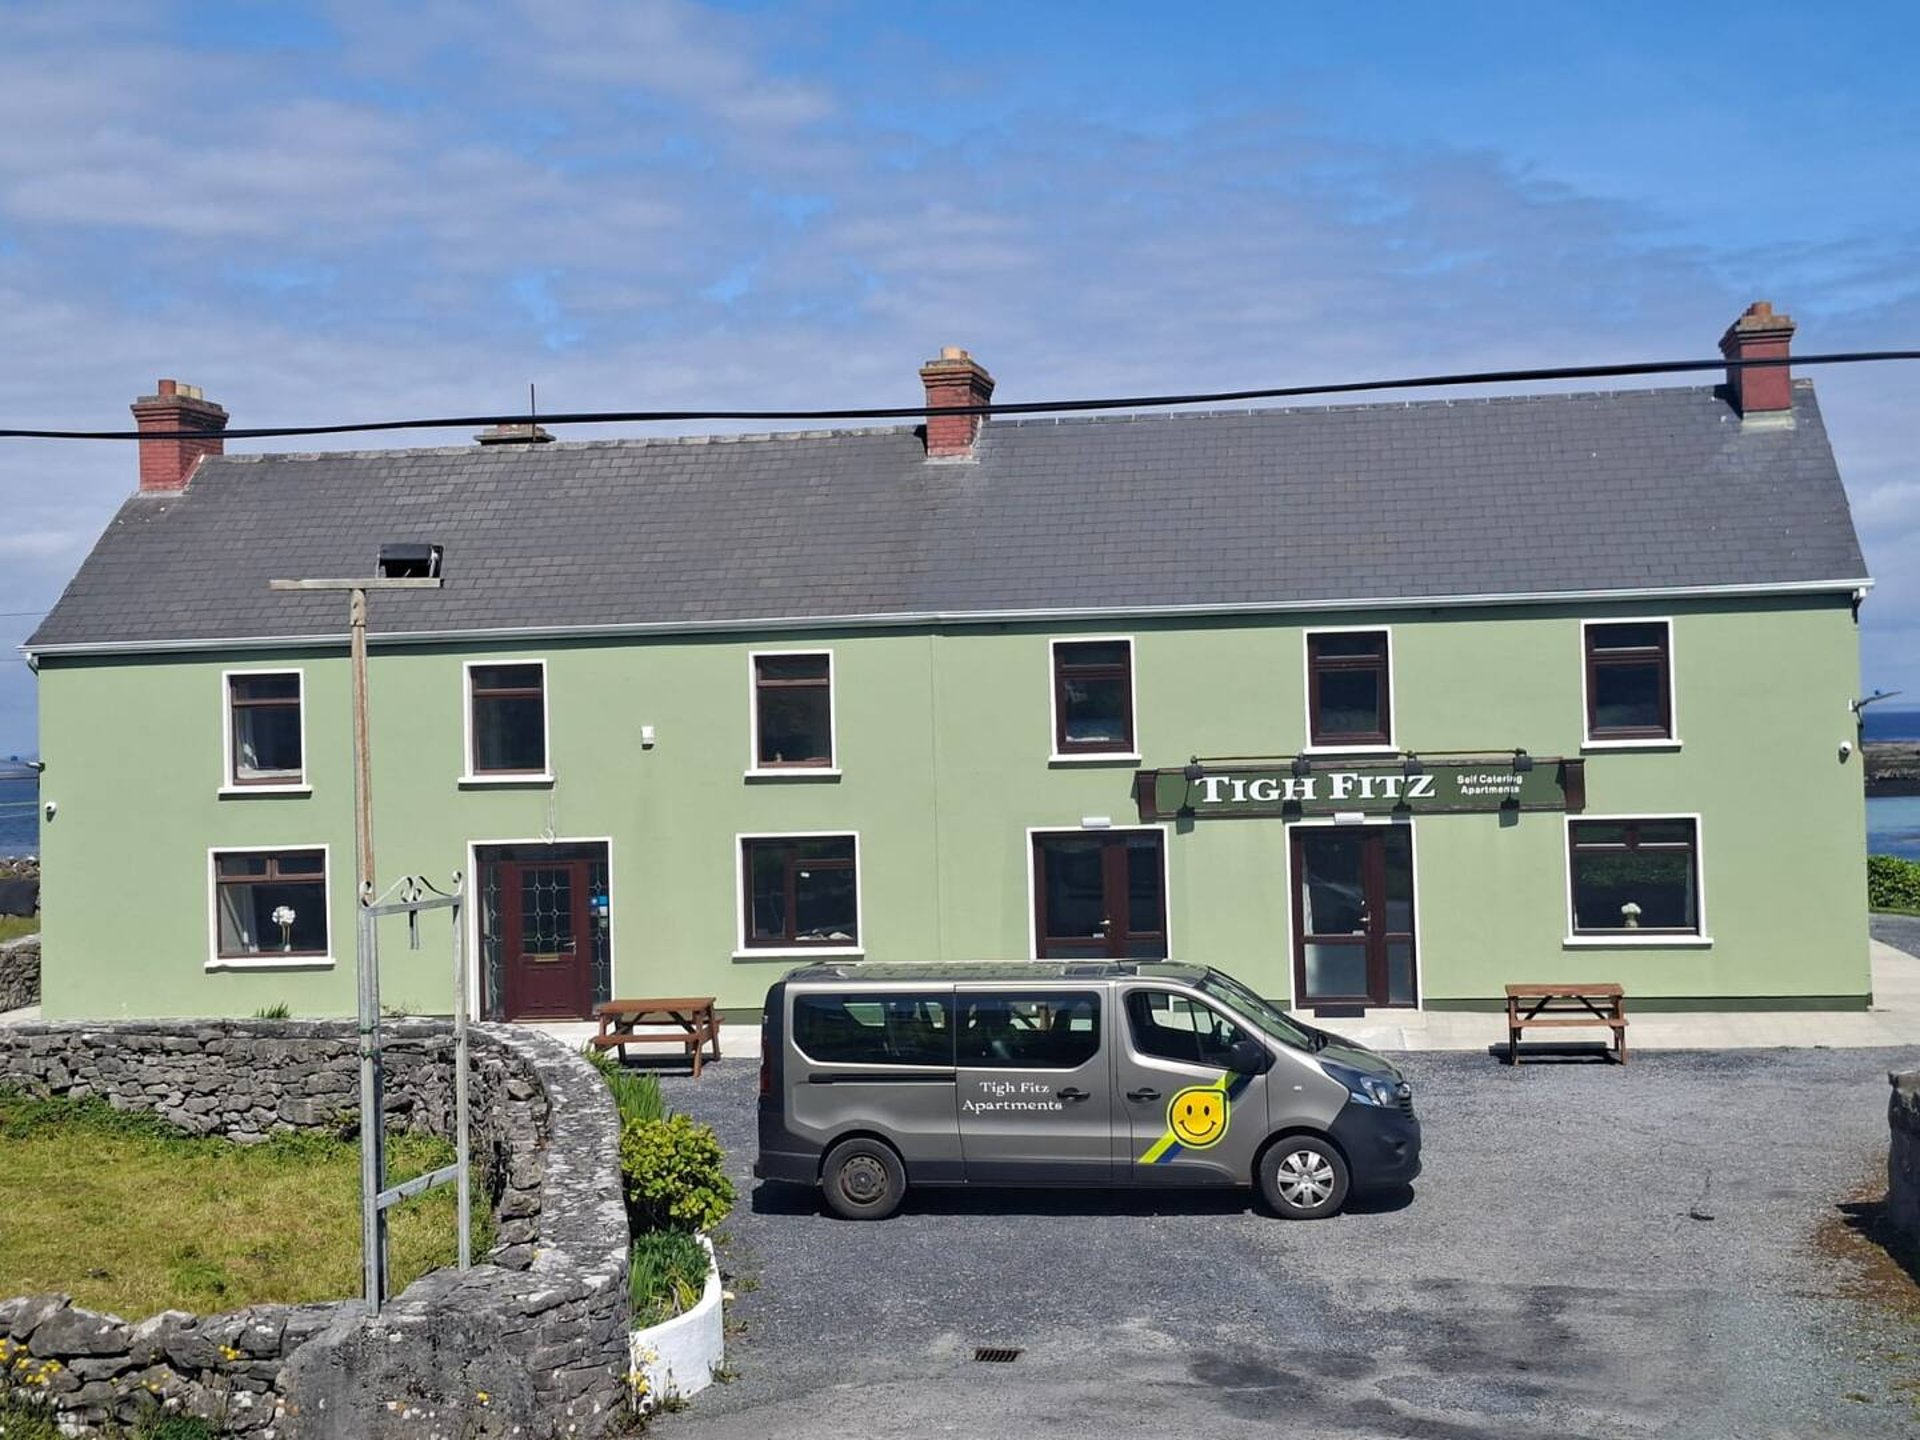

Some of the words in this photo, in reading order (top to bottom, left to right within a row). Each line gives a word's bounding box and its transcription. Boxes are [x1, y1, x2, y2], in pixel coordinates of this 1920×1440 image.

[1456, 774, 1477, 785] Self
[1479, 773, 1523, 785] Catering
[1460, 785, 1520, 796] Apartments
[979, 1081, 1016, 1097] Tigh
[1020, 1081, 1050, 1093] Fitz
[962, 1099, 1063, 1115] Apartments
